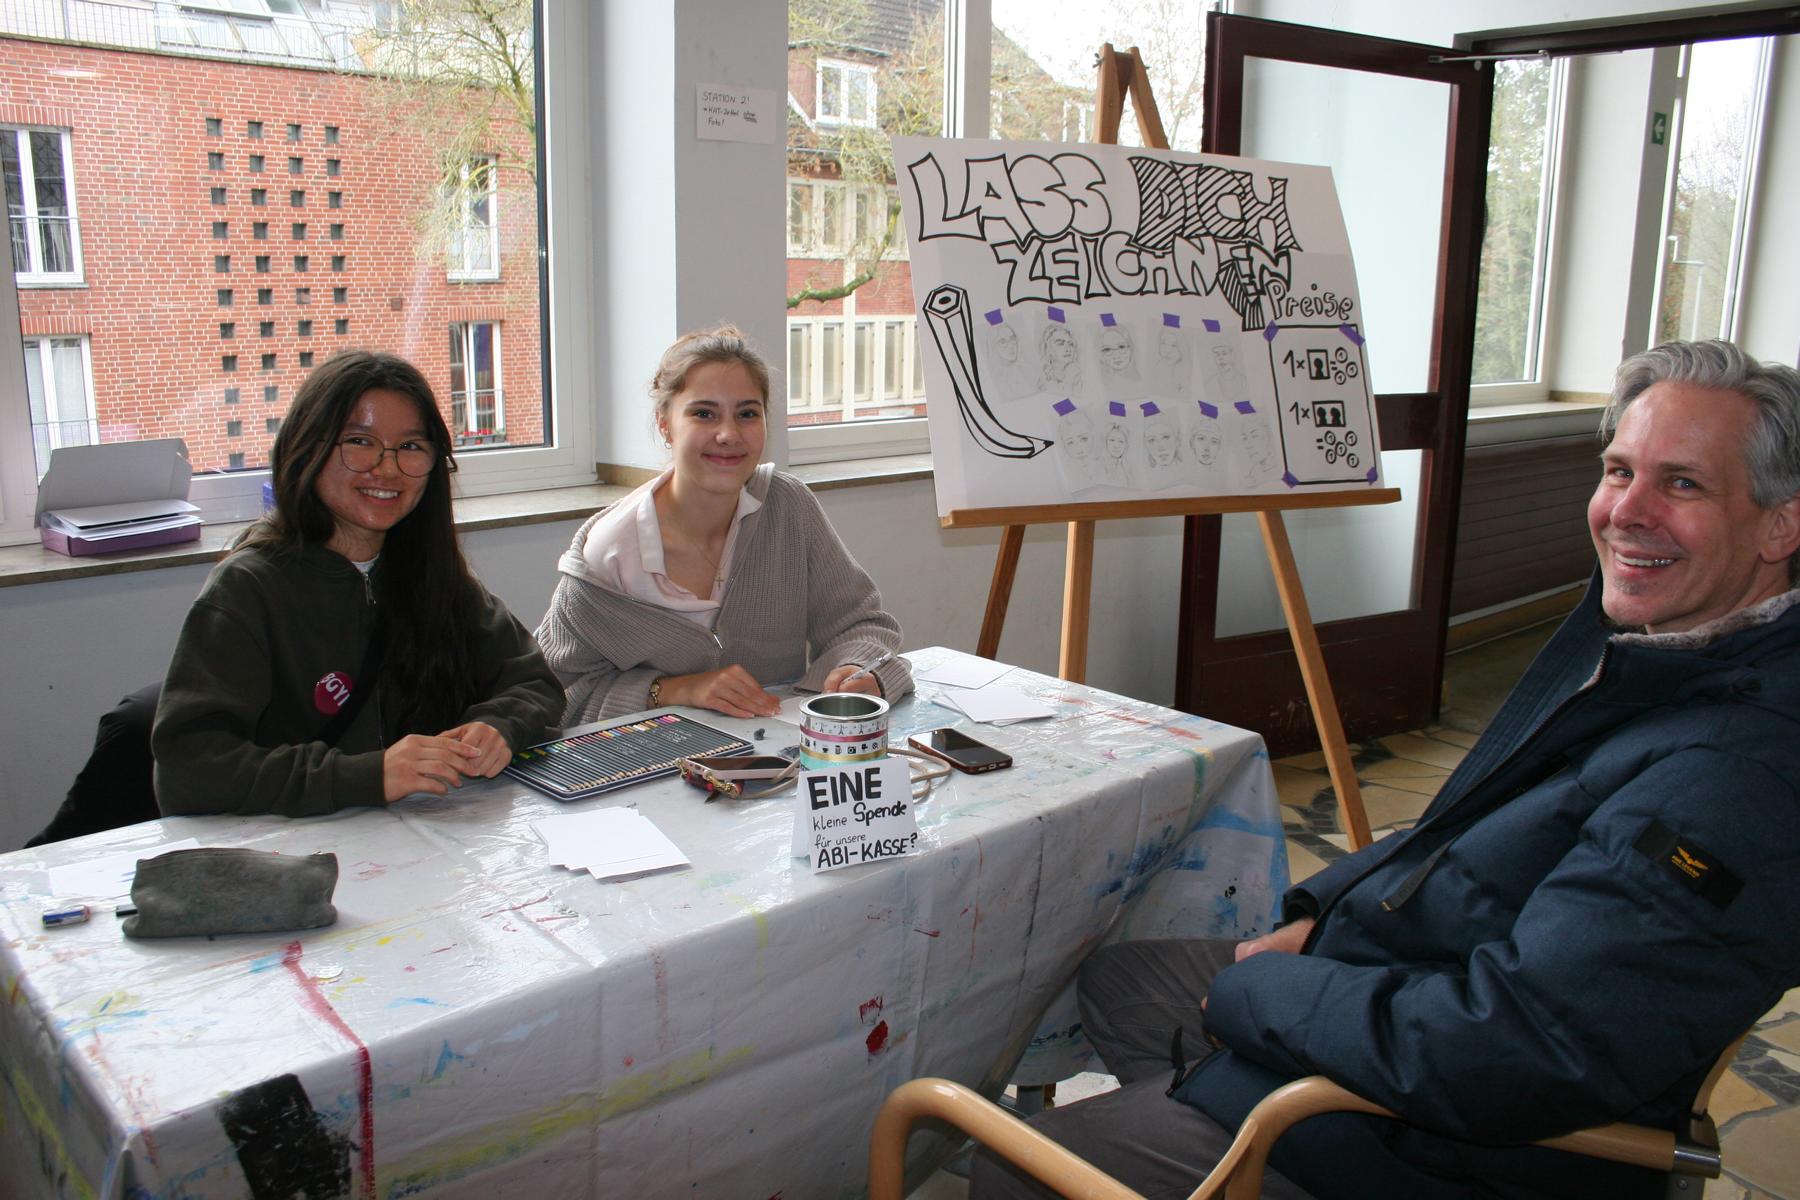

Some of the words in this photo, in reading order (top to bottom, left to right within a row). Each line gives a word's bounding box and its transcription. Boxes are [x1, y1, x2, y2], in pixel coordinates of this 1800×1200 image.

[703, 91, 736, 104] STATION
[907, 152, 1112, 247] LASS
[1128, 156, 1303, 252] DICH
[990, 230, 1291, 306] ZEICHNEN
[1265, 279, 1354, 321] Preise
[807, 767, 882, 810] EINE
[813, 816, 848, 832] kleine
[853, 801, 907, 826] Spende
[815, 833, 832, 849] für
[836, 834, 867, 846] unsere
[818, 832, 918, 868] ABI-KASSE?
